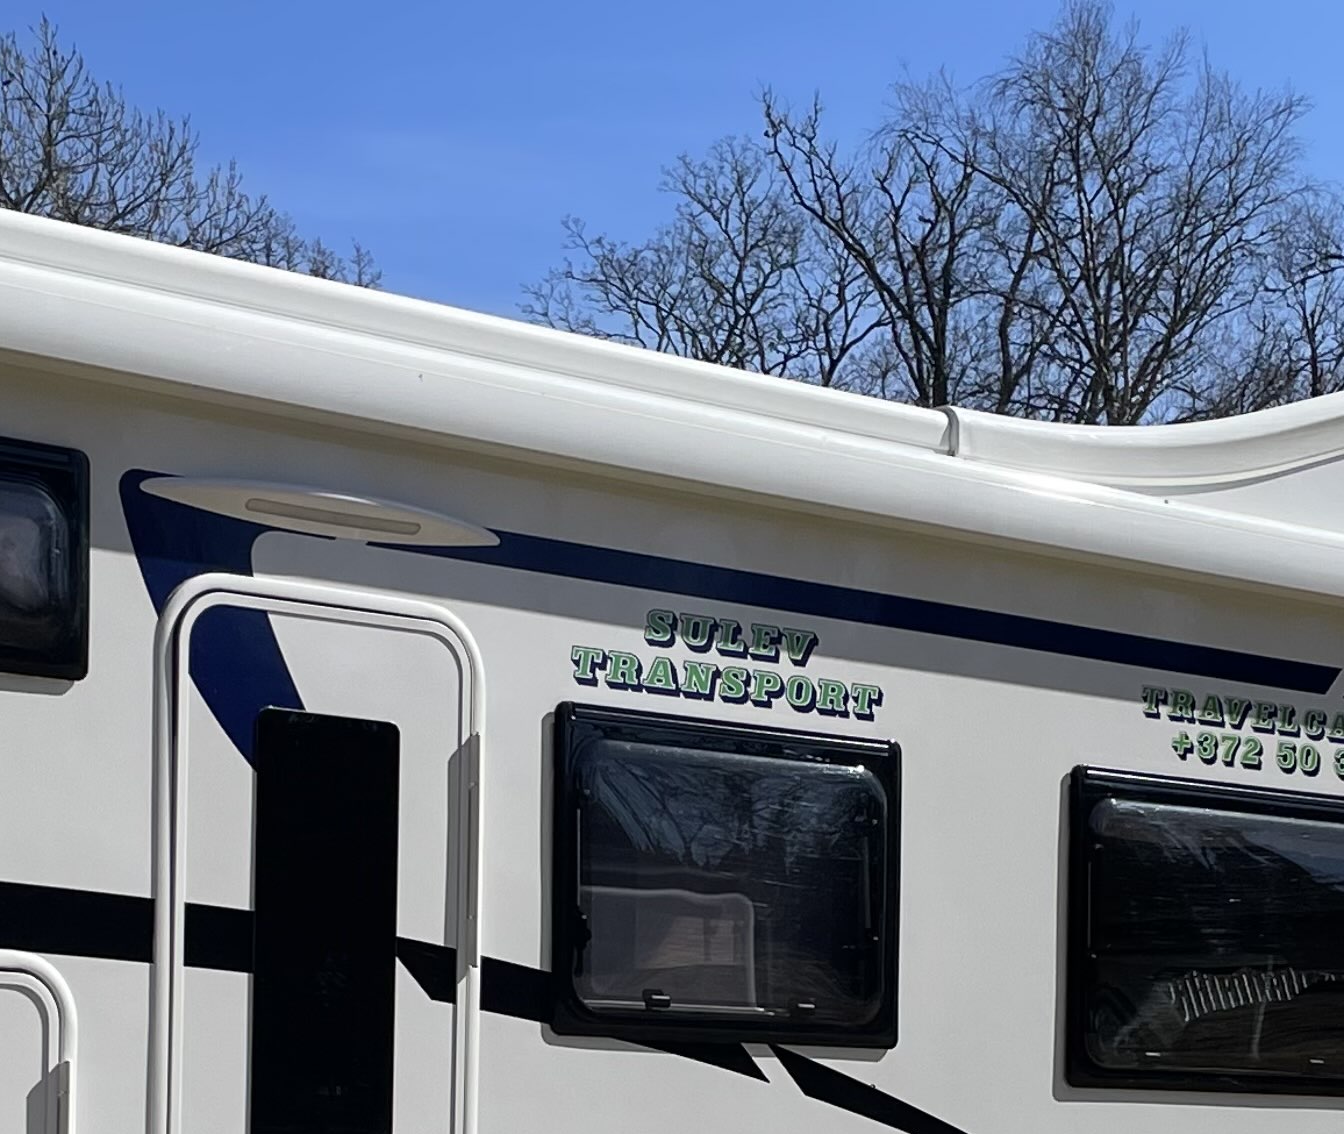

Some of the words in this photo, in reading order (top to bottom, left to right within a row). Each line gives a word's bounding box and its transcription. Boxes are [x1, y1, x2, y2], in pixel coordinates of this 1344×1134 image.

[644, 608, 819, 666] SULEV
[571, 645, 884, 722] TRANSPORT
[1171, 730, 1263, 770] +372
[1276, 740, 1321, 778] 50
